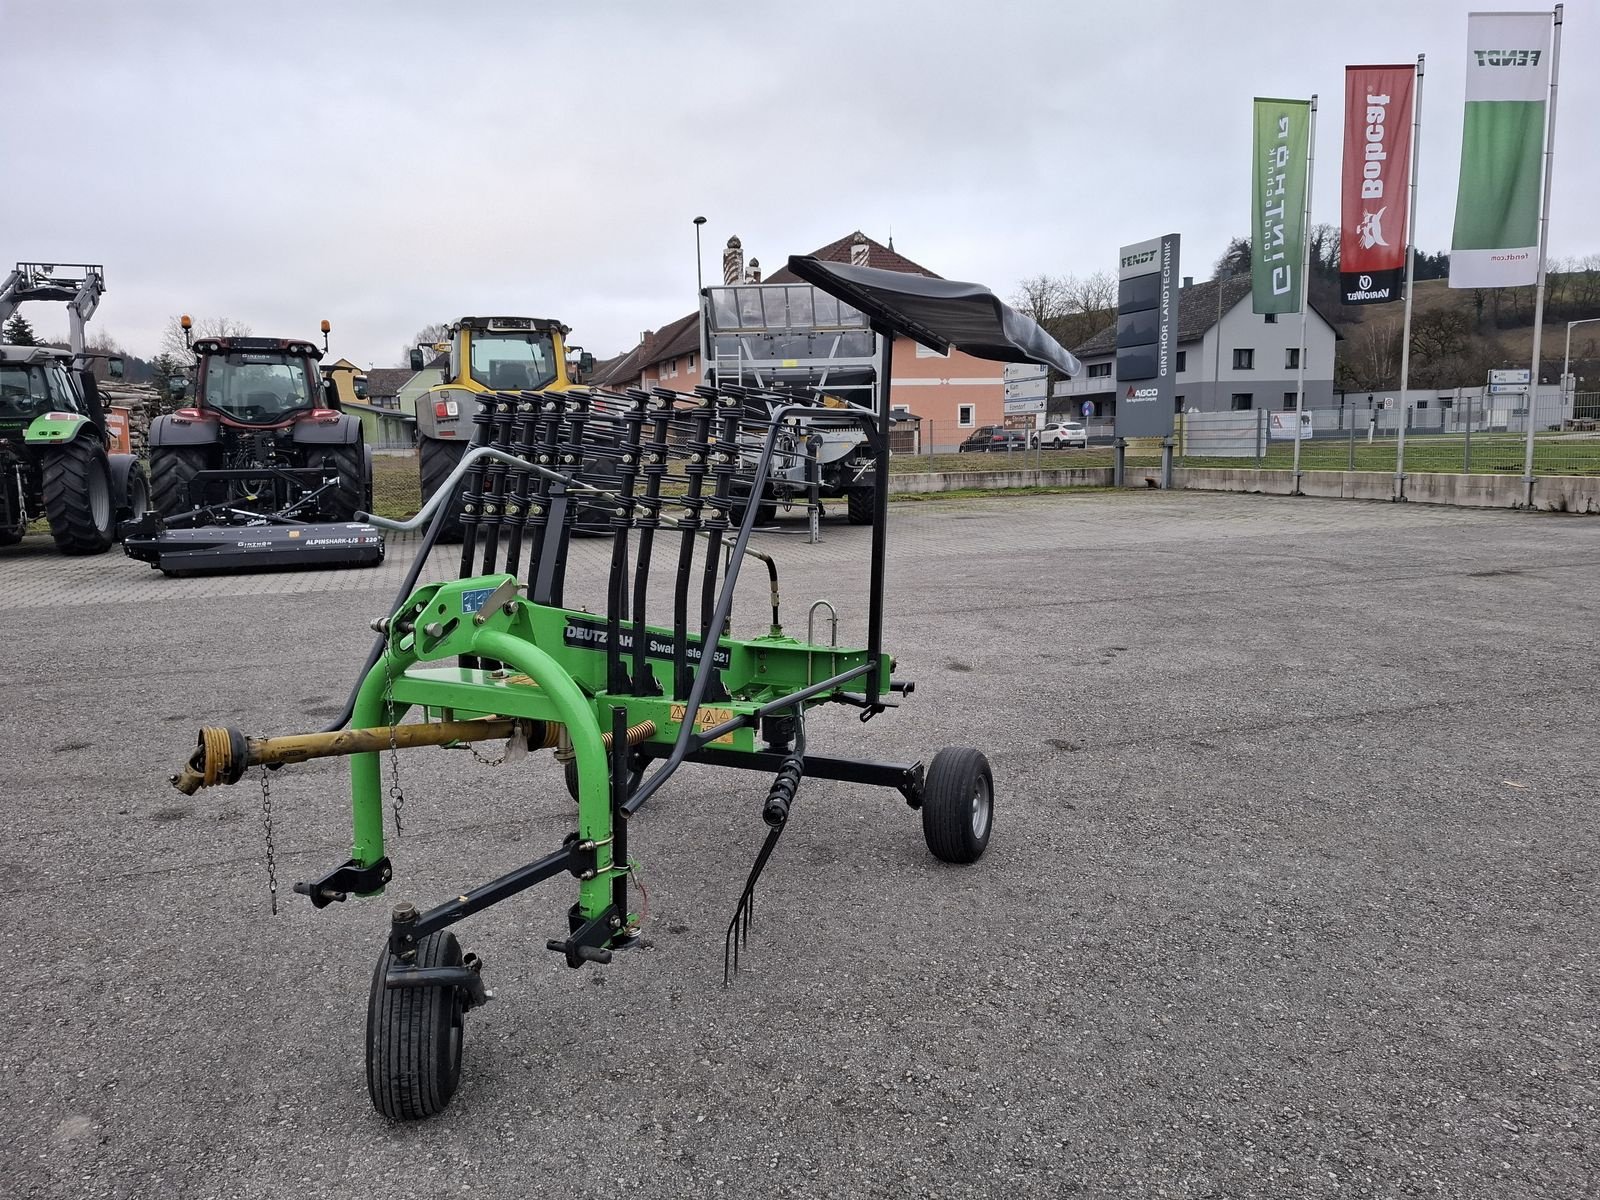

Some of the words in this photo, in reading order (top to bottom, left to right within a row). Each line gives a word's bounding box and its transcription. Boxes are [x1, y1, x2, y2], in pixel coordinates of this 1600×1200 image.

[1121, 250, 1158, 268] FENDT
[1162, 241, 1171, 322] LANDTECHNIK
[1135, 388, 1158, 397] AGCO
